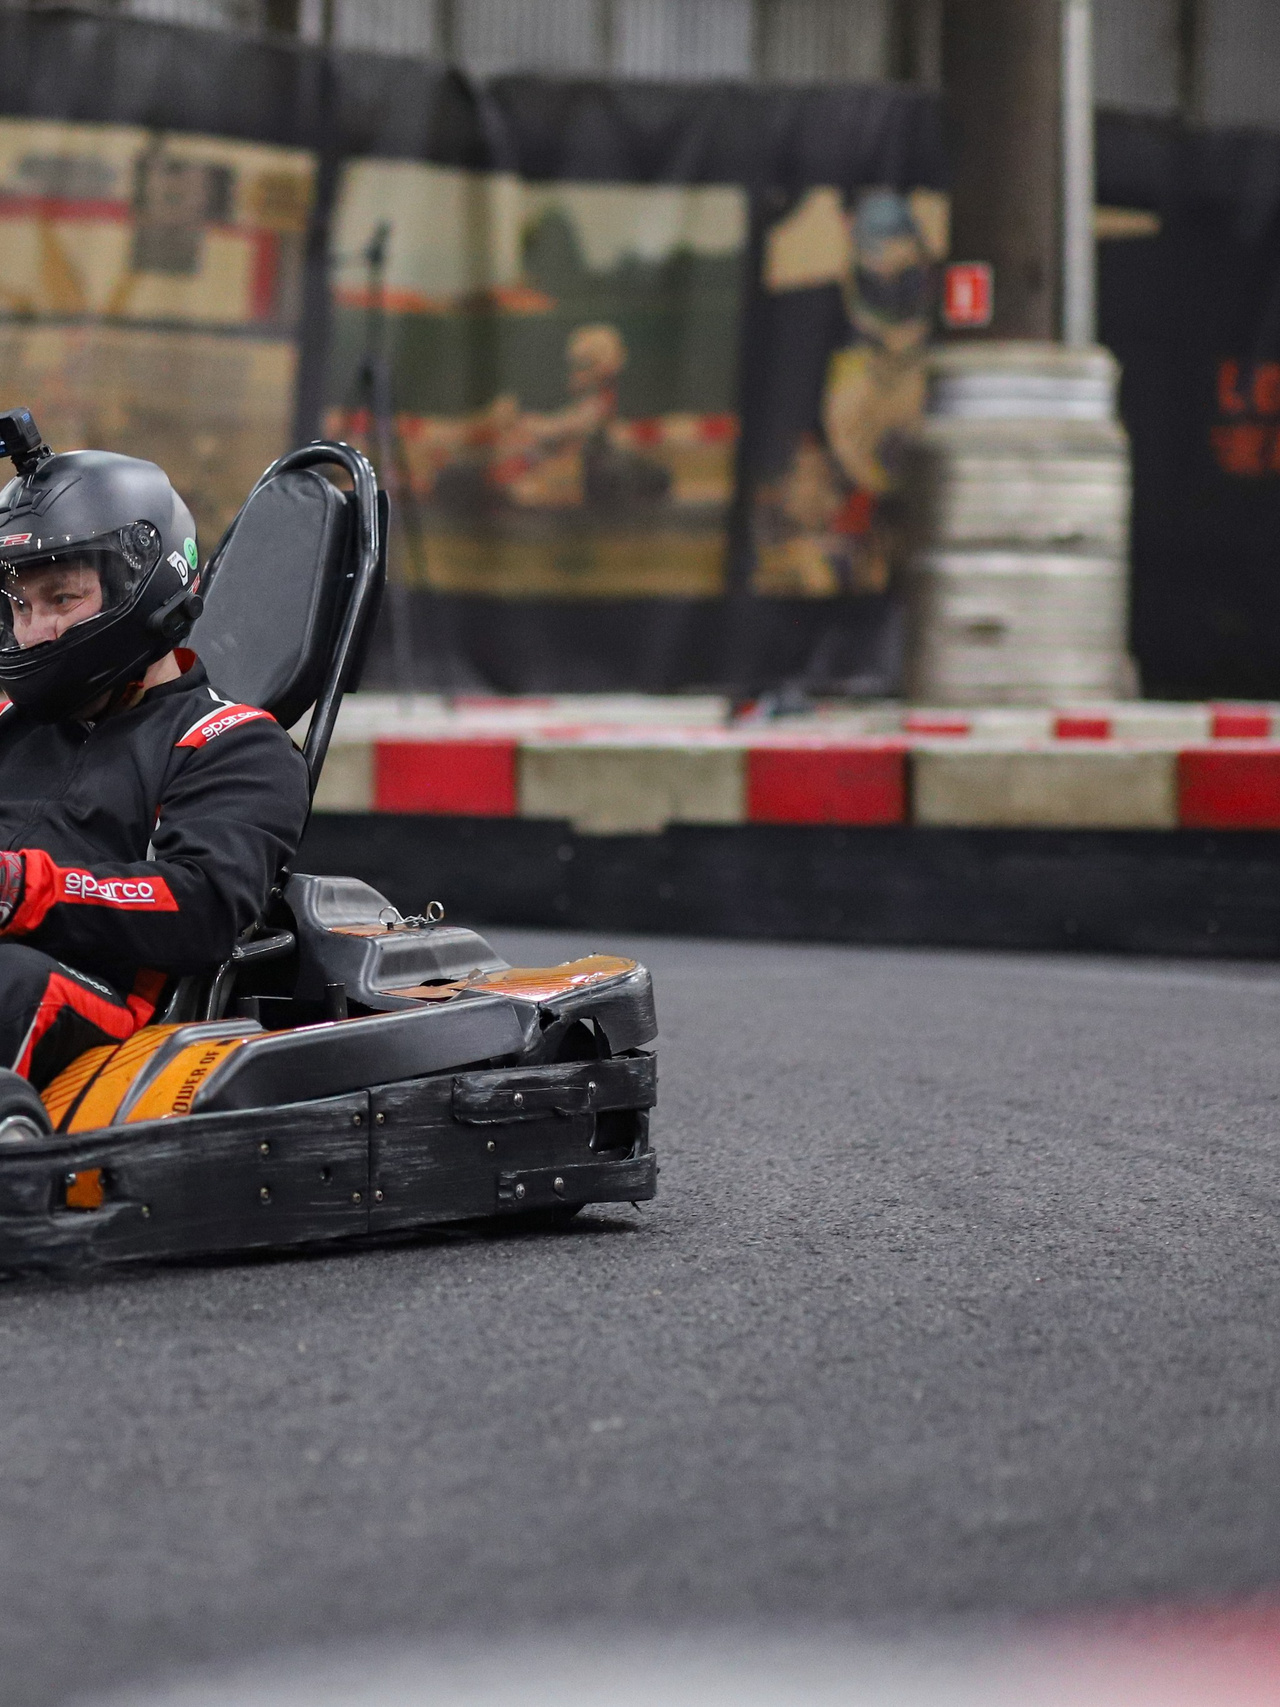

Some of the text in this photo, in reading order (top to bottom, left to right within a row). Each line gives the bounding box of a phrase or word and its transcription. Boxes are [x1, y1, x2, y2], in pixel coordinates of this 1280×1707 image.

[201, 710, 263, 739] sparco
[65, 873, 154, 901] sparco
[172, 1050, 220, 1112] OWER OF
